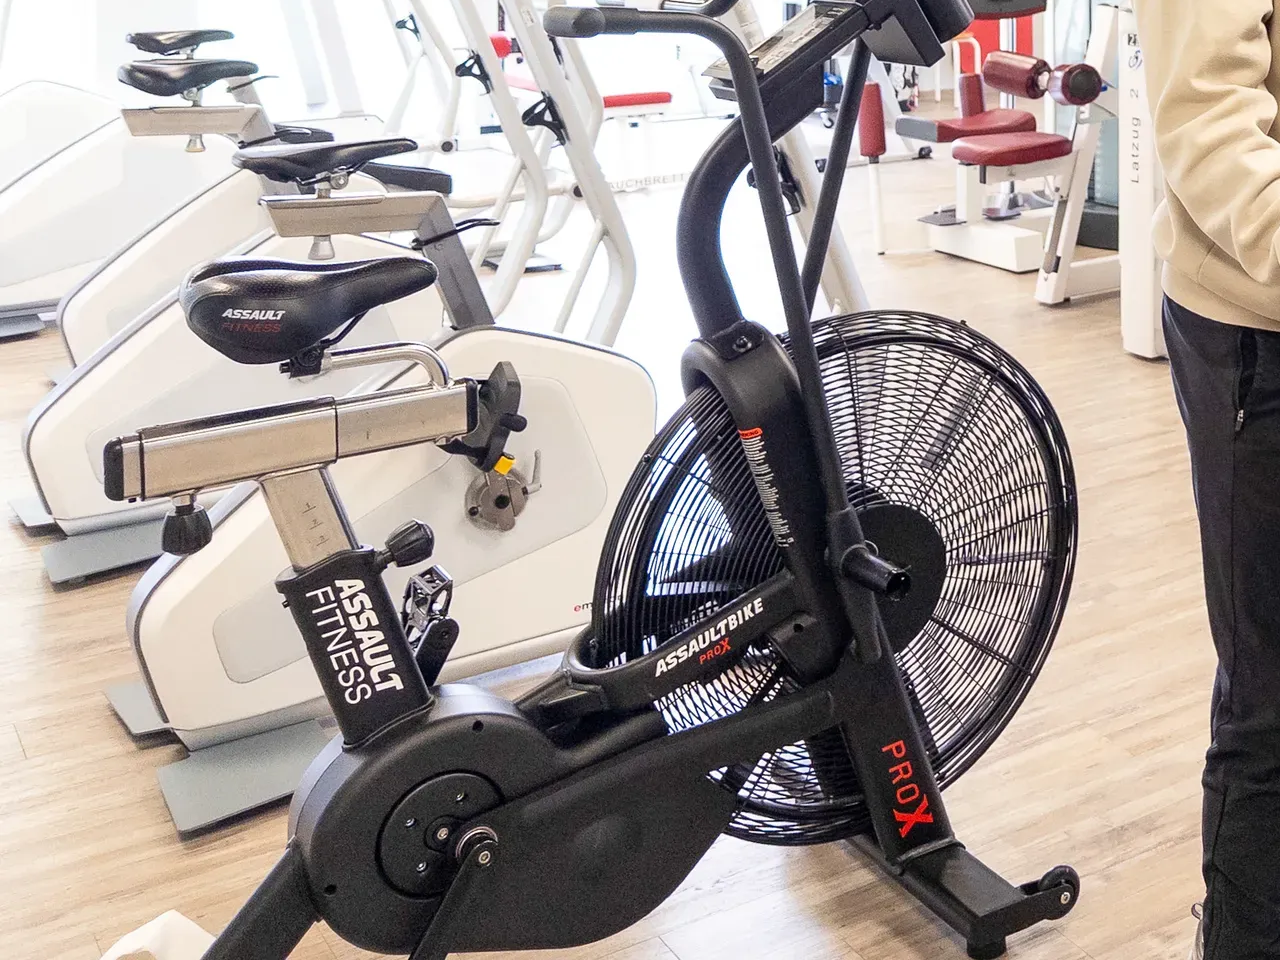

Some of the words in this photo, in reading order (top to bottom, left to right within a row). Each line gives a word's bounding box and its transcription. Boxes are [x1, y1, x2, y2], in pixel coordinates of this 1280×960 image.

[1131, 116, 1141, 184] Latzug
[221, 308, 286, 320] ASSAULT
[221, 322, 281, 333] FITNESS
[305, 585, 372, 705] FITNESS
[334, 579, 405, 692] ASSAULT
[655, 597, 764, 678] ASSAULTBIKE
[699, 637, 732, 665] PROX
[881, 739, 934, 838] PROX
